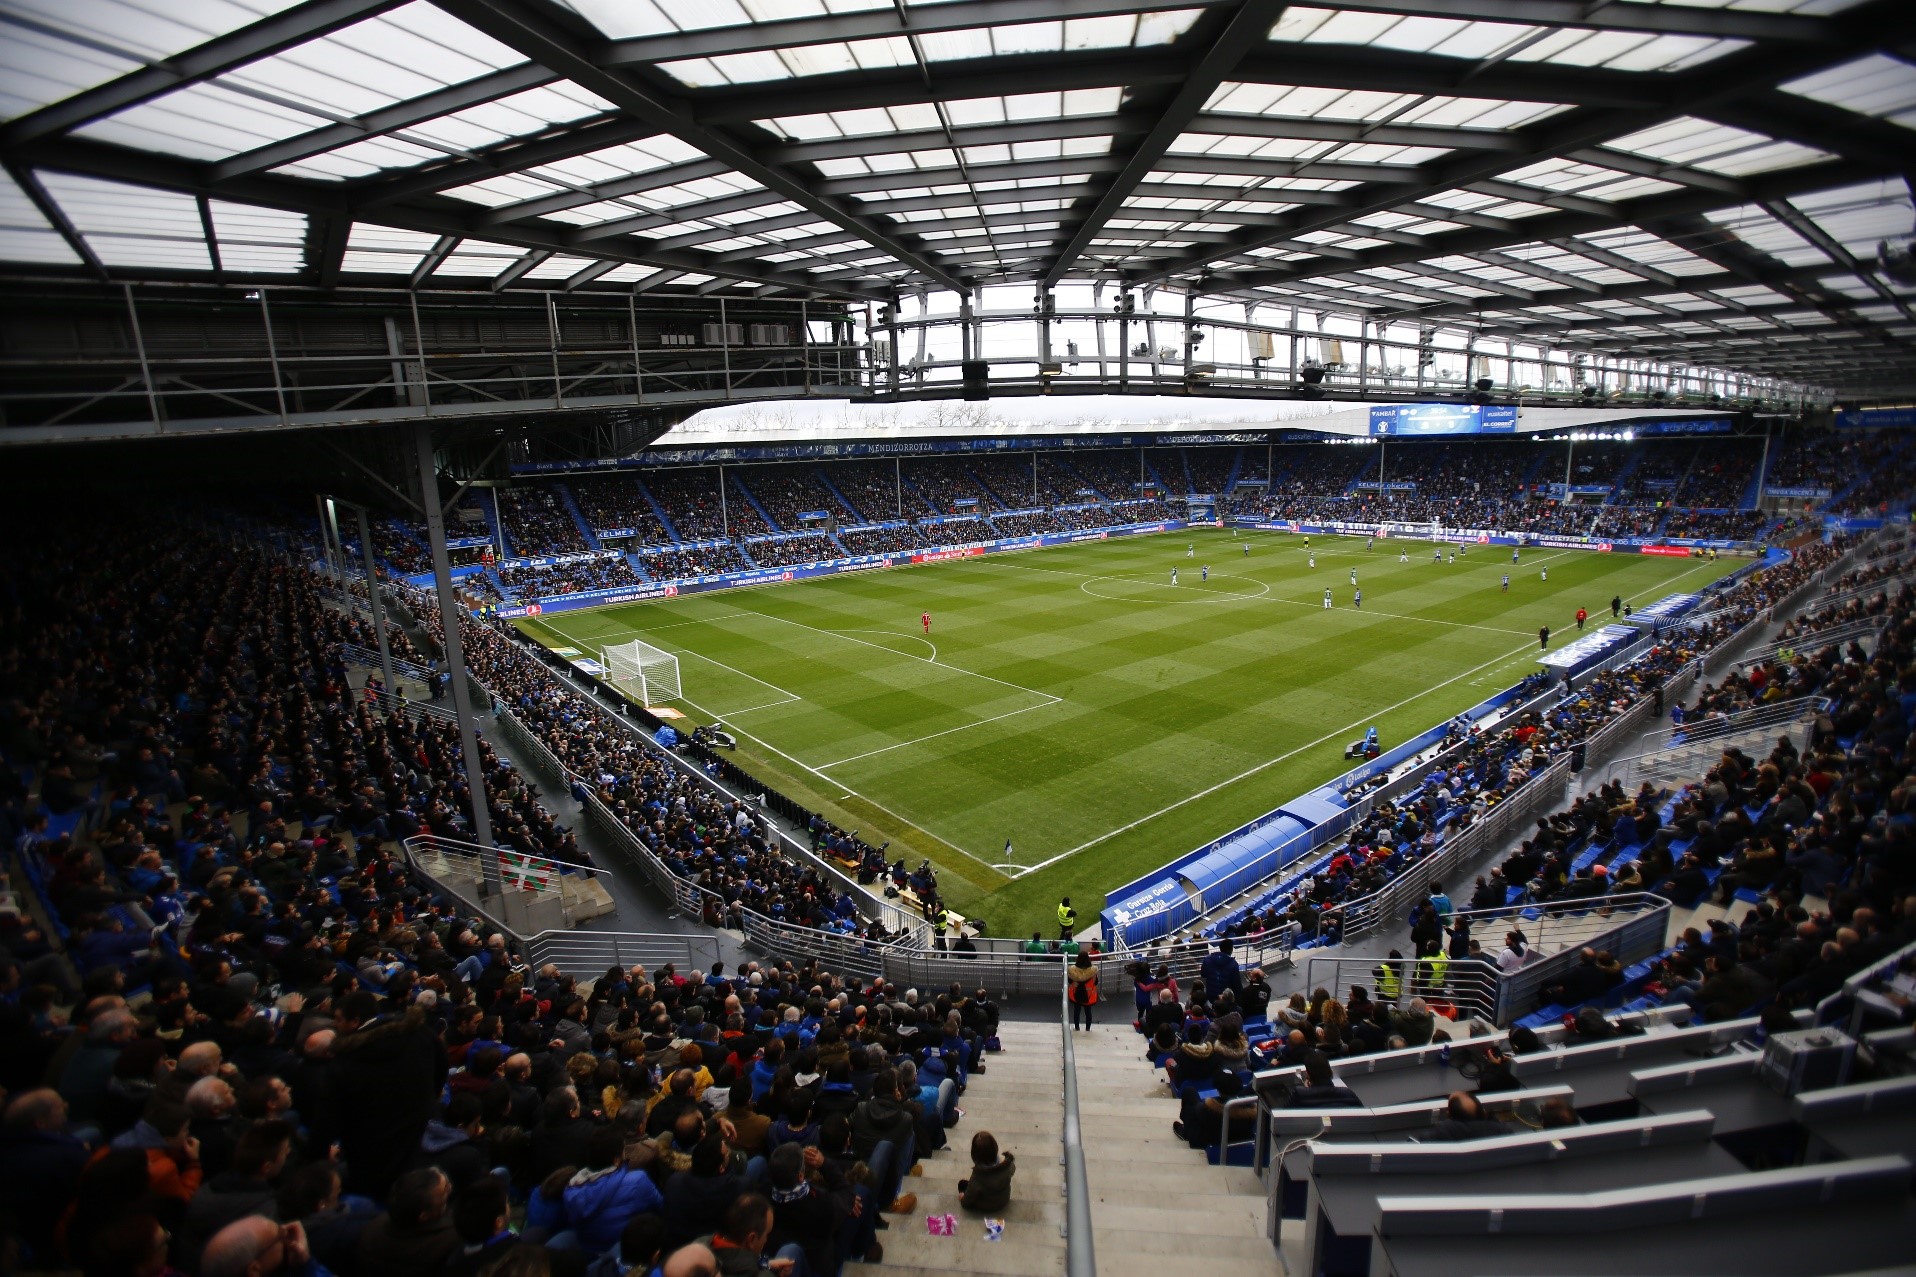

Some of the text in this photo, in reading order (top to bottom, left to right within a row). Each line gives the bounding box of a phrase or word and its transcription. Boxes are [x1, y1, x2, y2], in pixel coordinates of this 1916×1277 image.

[1375, 409, 1396, 417] AMBAR
[868, 443, 933, 453] MENDIZORROTZA
[730, 576, 756, 586] TURKISH
[756, 574, 782, 583] AIRLINES
[604, 590, 665, 604] TURKISH AIRLINES
[500, 608, 526, 618] RLINES
[1354, 767, 1371, 781] LaLiga
[1152, 882, 1175, 896] Gorria
